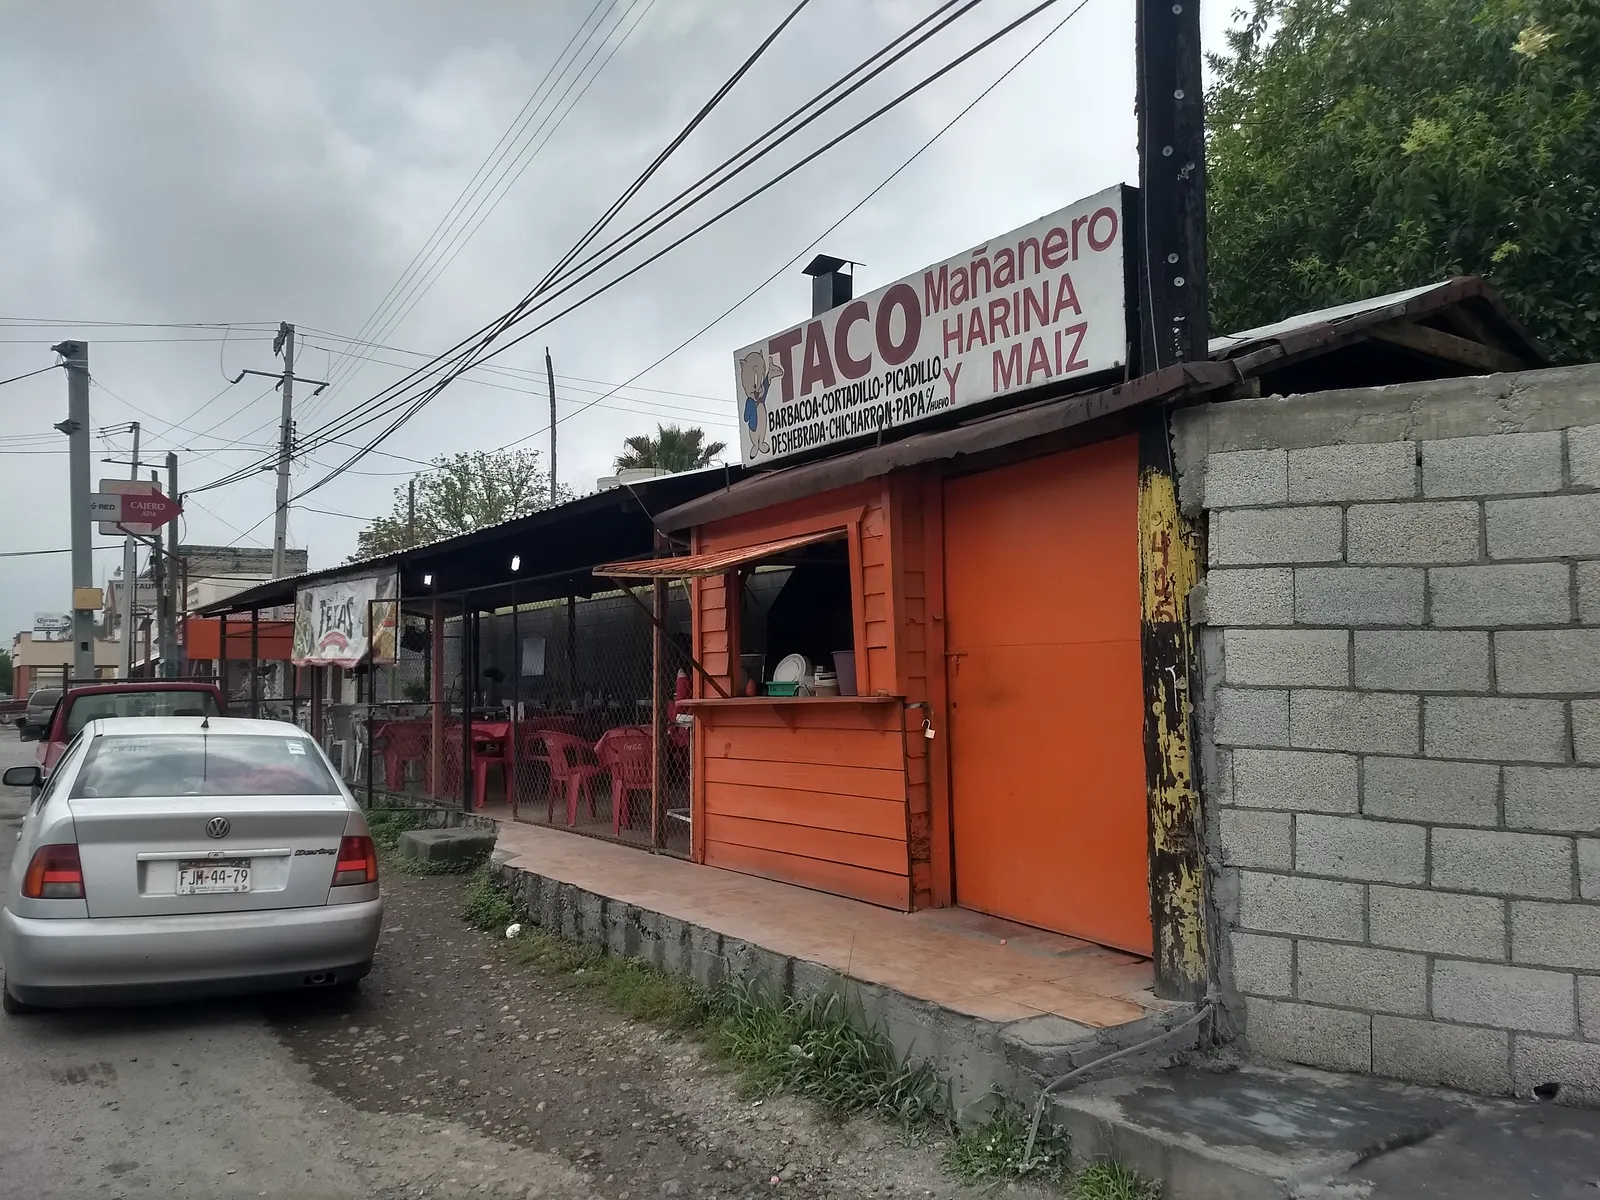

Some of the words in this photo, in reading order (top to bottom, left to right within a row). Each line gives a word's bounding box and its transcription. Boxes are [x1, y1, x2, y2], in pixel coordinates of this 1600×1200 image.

[924, 206, 1118, 317] Mañanero
[768, 284, 921, 402] TACO
[943, 272, 1082, 359] HARINA
[768, 396, 819, 432] BARBACOA
[820, 376, 880, 416] CORTADILLO
[885, 356, 941, 397] PICADILLO
[943, 362, 962, 405] Y
[992, 321, 1089, 393] MAIZ
[771, 420, 826, 455] DESHEBRADA
[895, 389, 925, 422] PAPA
[98, 503, 115, 511] RED
[130, 501, 165, 511] CAJERO
